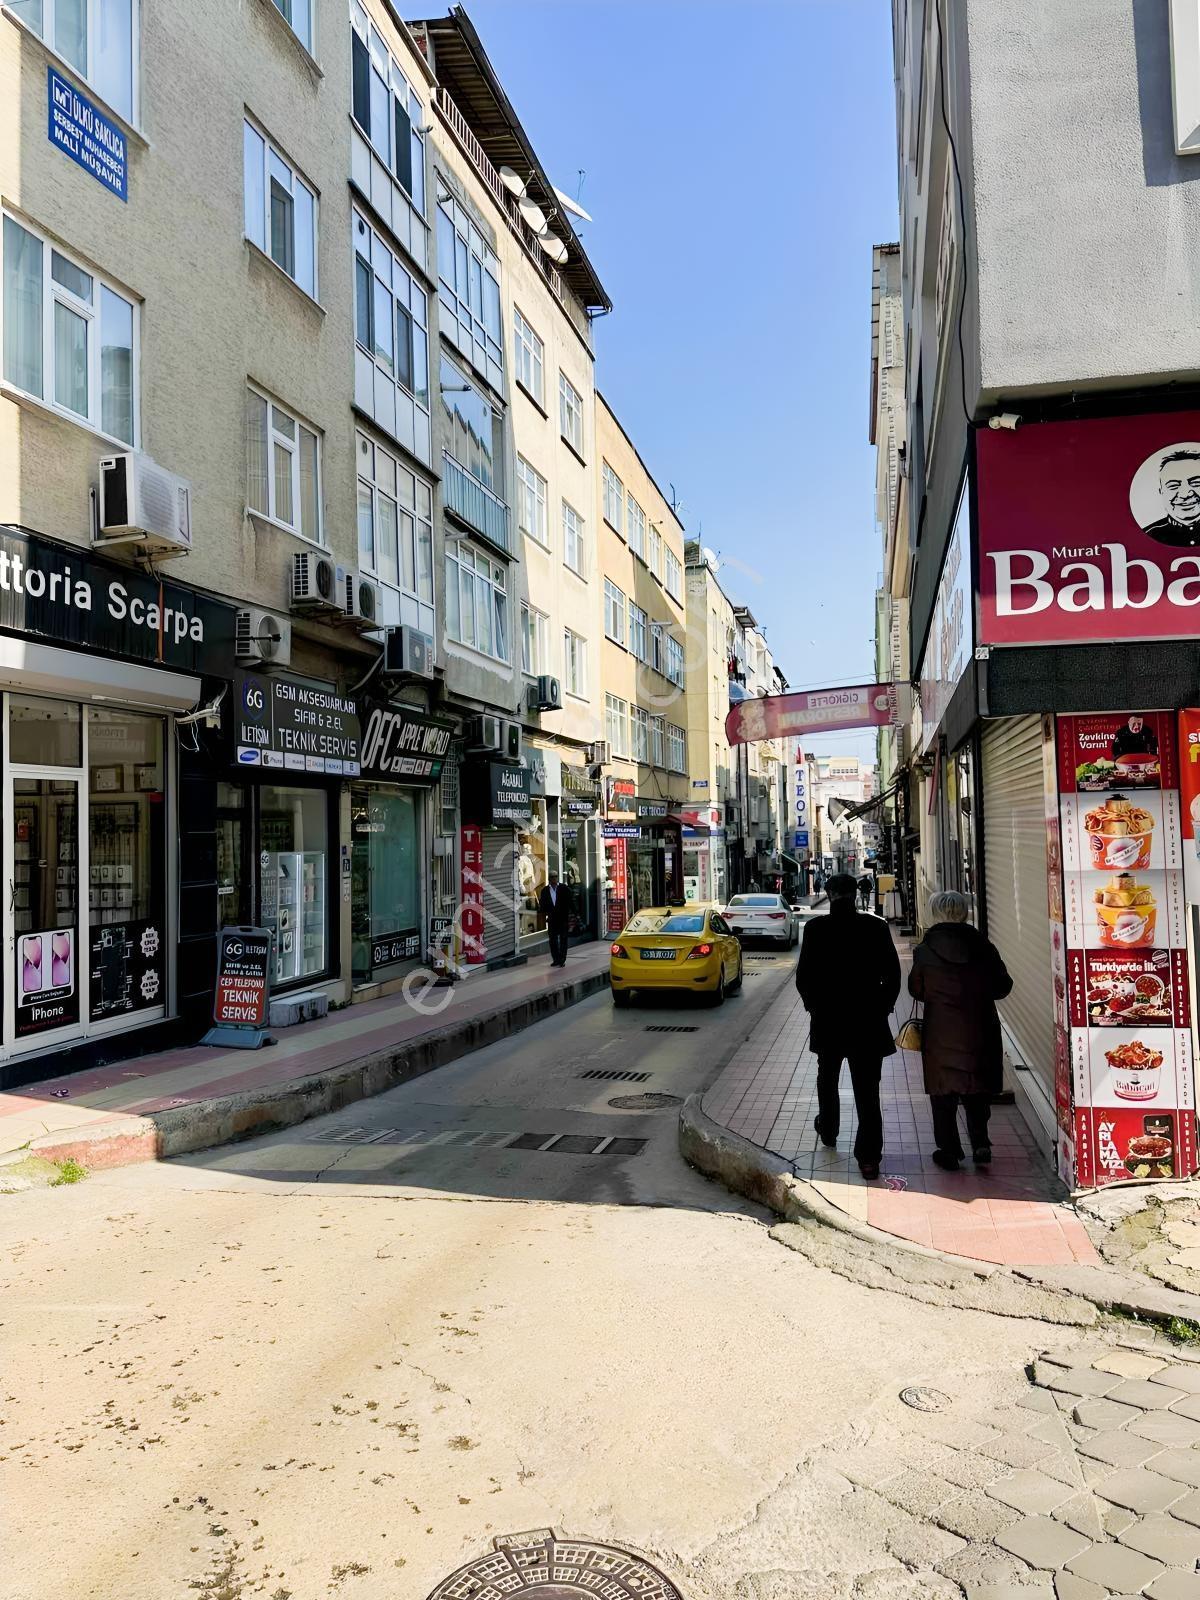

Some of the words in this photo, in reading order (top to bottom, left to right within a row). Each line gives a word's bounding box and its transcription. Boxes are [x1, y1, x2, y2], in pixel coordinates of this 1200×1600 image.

[53, 108, 84, 142] SERBEST
[73, 93, 94, 133] ÜLKÜ
[95, 118, 124, 162] SAKLICA
[54, 125, 79, 155] MALİ
[81, 147, 122, 191] MÜŞAVİR
[1052, 545, 1101, 559] Murat
[107, 581, 204, 644] Scarpa
[246, 688, 263, 709] 6G
[276, 683, 296, 701] GSM
[298, 689, 356, 715] AKSESUARLARI
[294, 708, 316, 726] SIFIR
[278, 727, 318, 753] TEKNİK
[319, 736, 357, 758] SERVİS
[360, 708, 402, 771] OFC
[397, 722, 424, 752] APPLE
[421, 726, 450, 755] WORLD
[795, 769, 806, 827] TEOL
[226, 943, 242, 955] 6G
[1089, 961, 1143, 973] Türkiye'de
[1143, 960, 1158, 971] İlk
[220, 978, 233, 986] CEP
[234, 979, 264, 988] TELEFONU
[223, 989, 259, 1004] TEKNİK
[221, 1006, 257, 1020] SERVİS
[1098, 1122, 1115, 1132] AY
[1099, 1140, 1116, 1151] LA
[1100, 1149, 1120, 1160] MA
